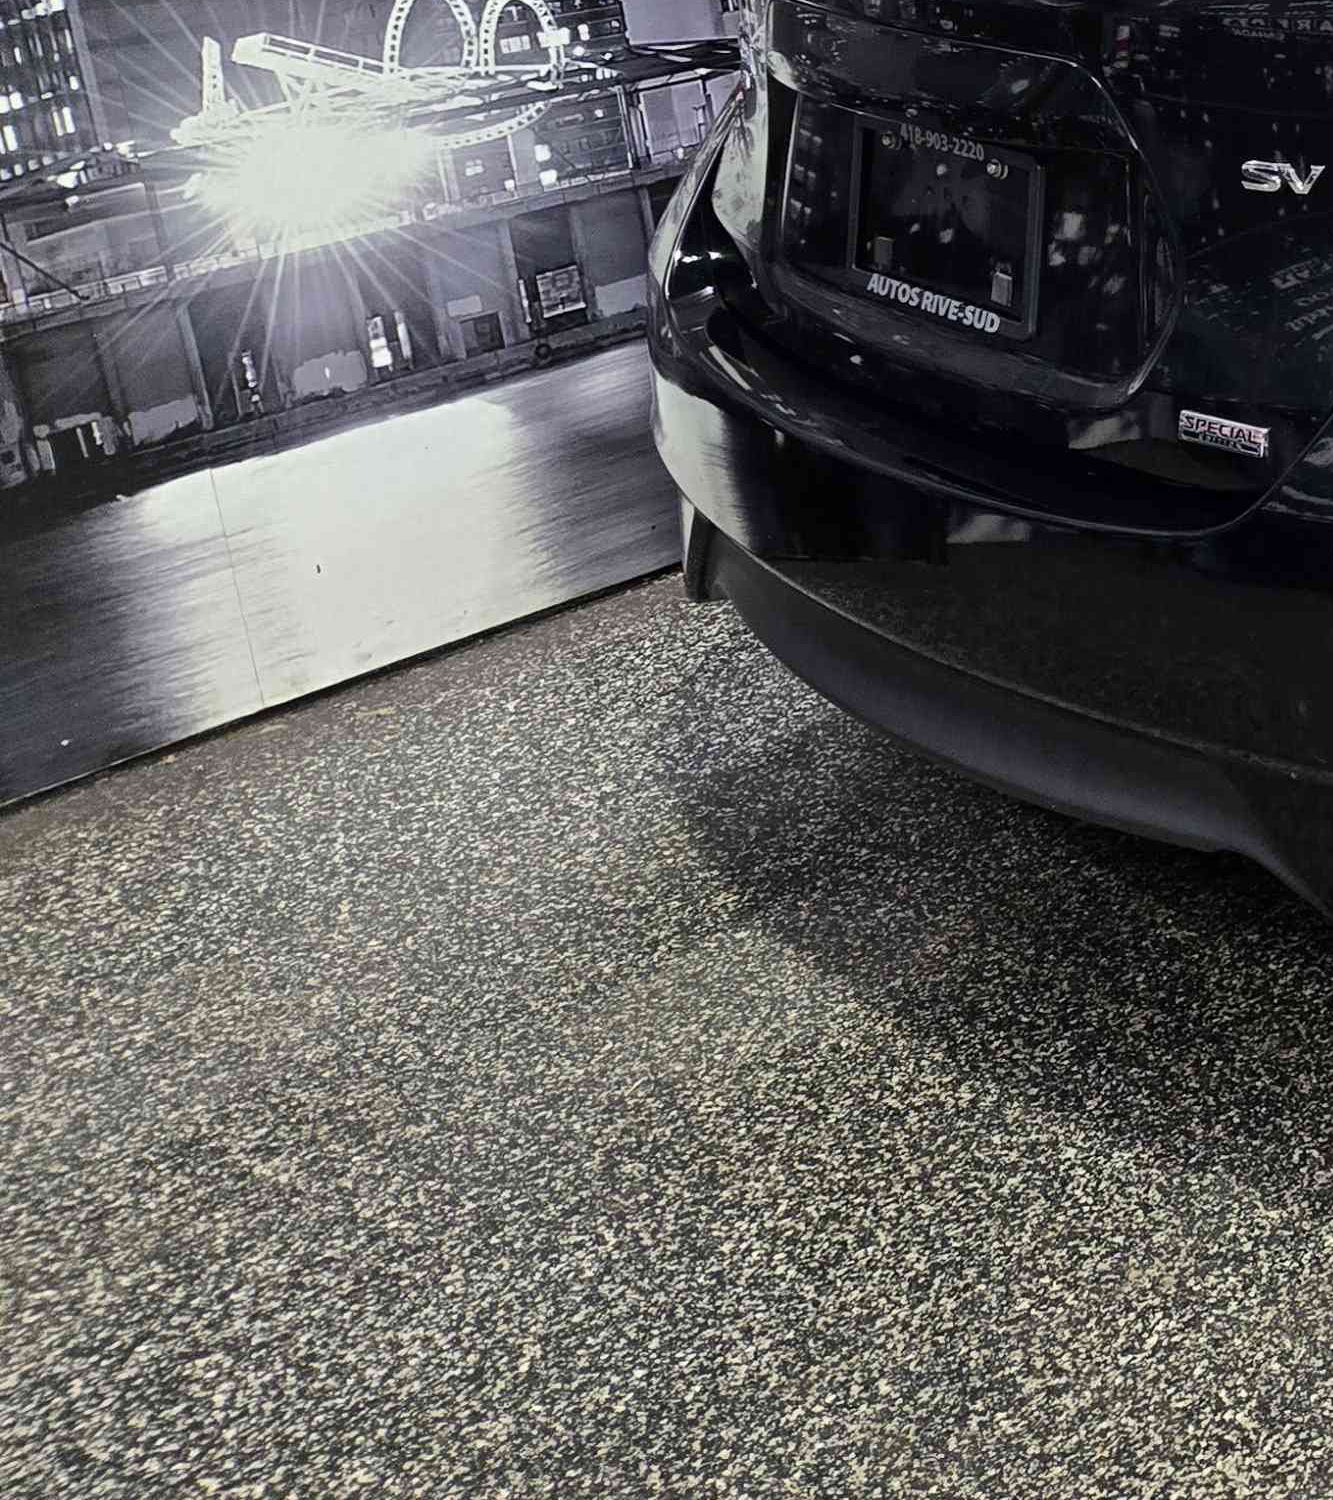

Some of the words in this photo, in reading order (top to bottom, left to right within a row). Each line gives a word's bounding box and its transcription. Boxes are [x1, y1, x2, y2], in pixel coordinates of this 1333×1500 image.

[1241, 160, 1326, 195] SV
[866, 273, 922, 307] AUTOS
[920, 291, 1001, 333] RIVE-SUD
[1183, 415, 1263, 446] SPECIAL
